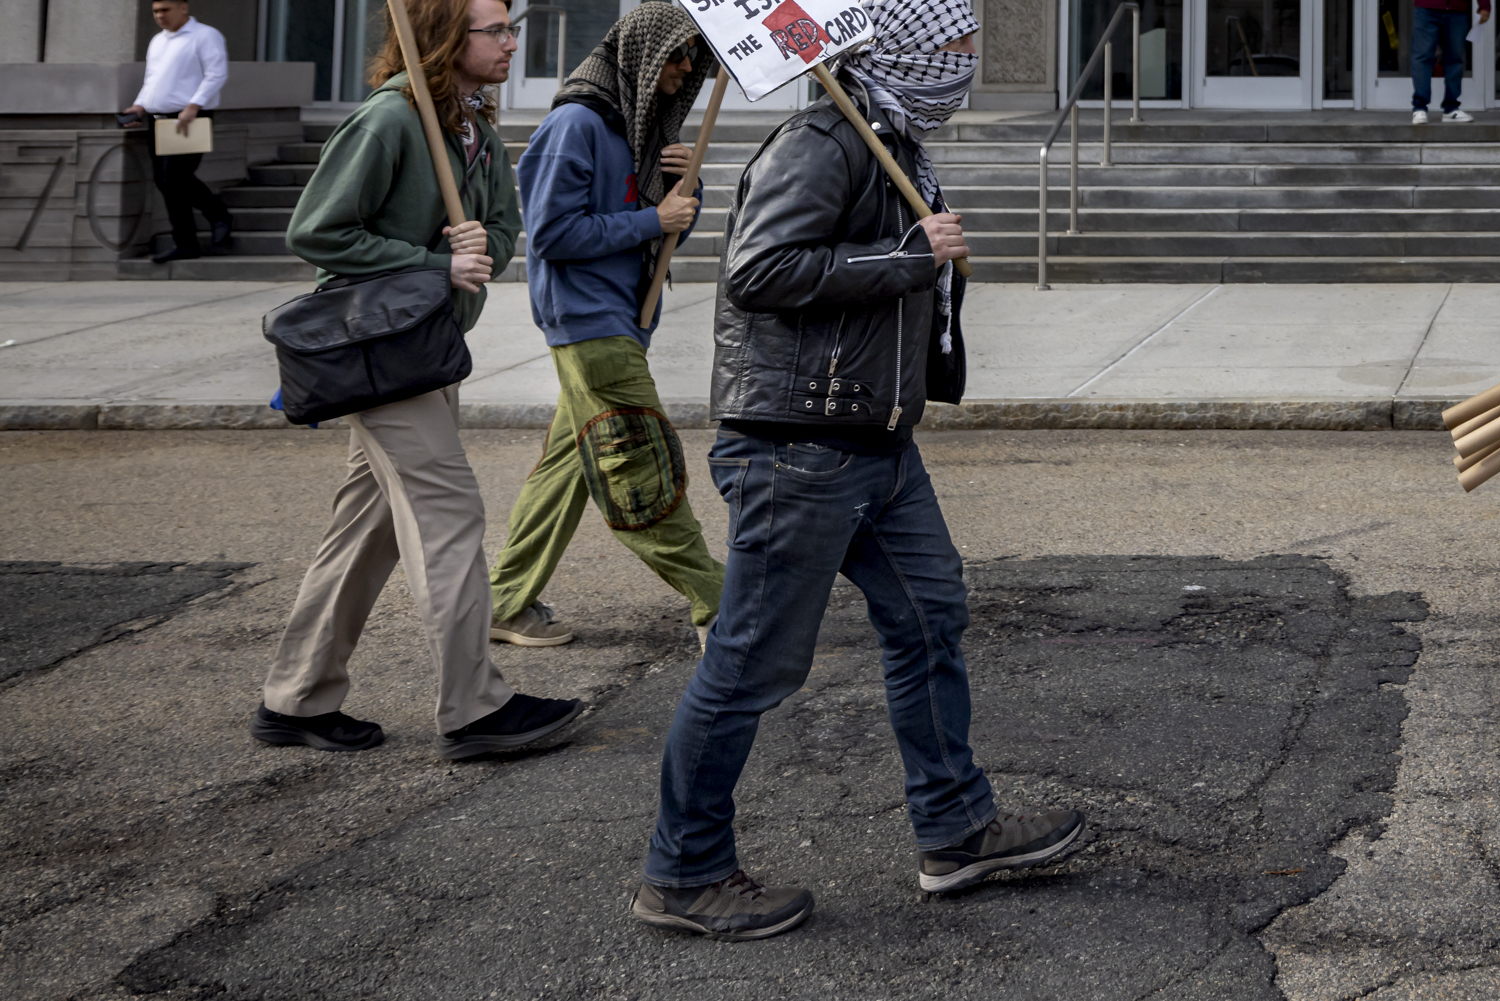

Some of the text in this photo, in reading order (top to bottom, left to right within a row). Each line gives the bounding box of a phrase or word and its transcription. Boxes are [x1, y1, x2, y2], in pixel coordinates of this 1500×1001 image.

[727, 6, 868, 61] THE RED CARD
